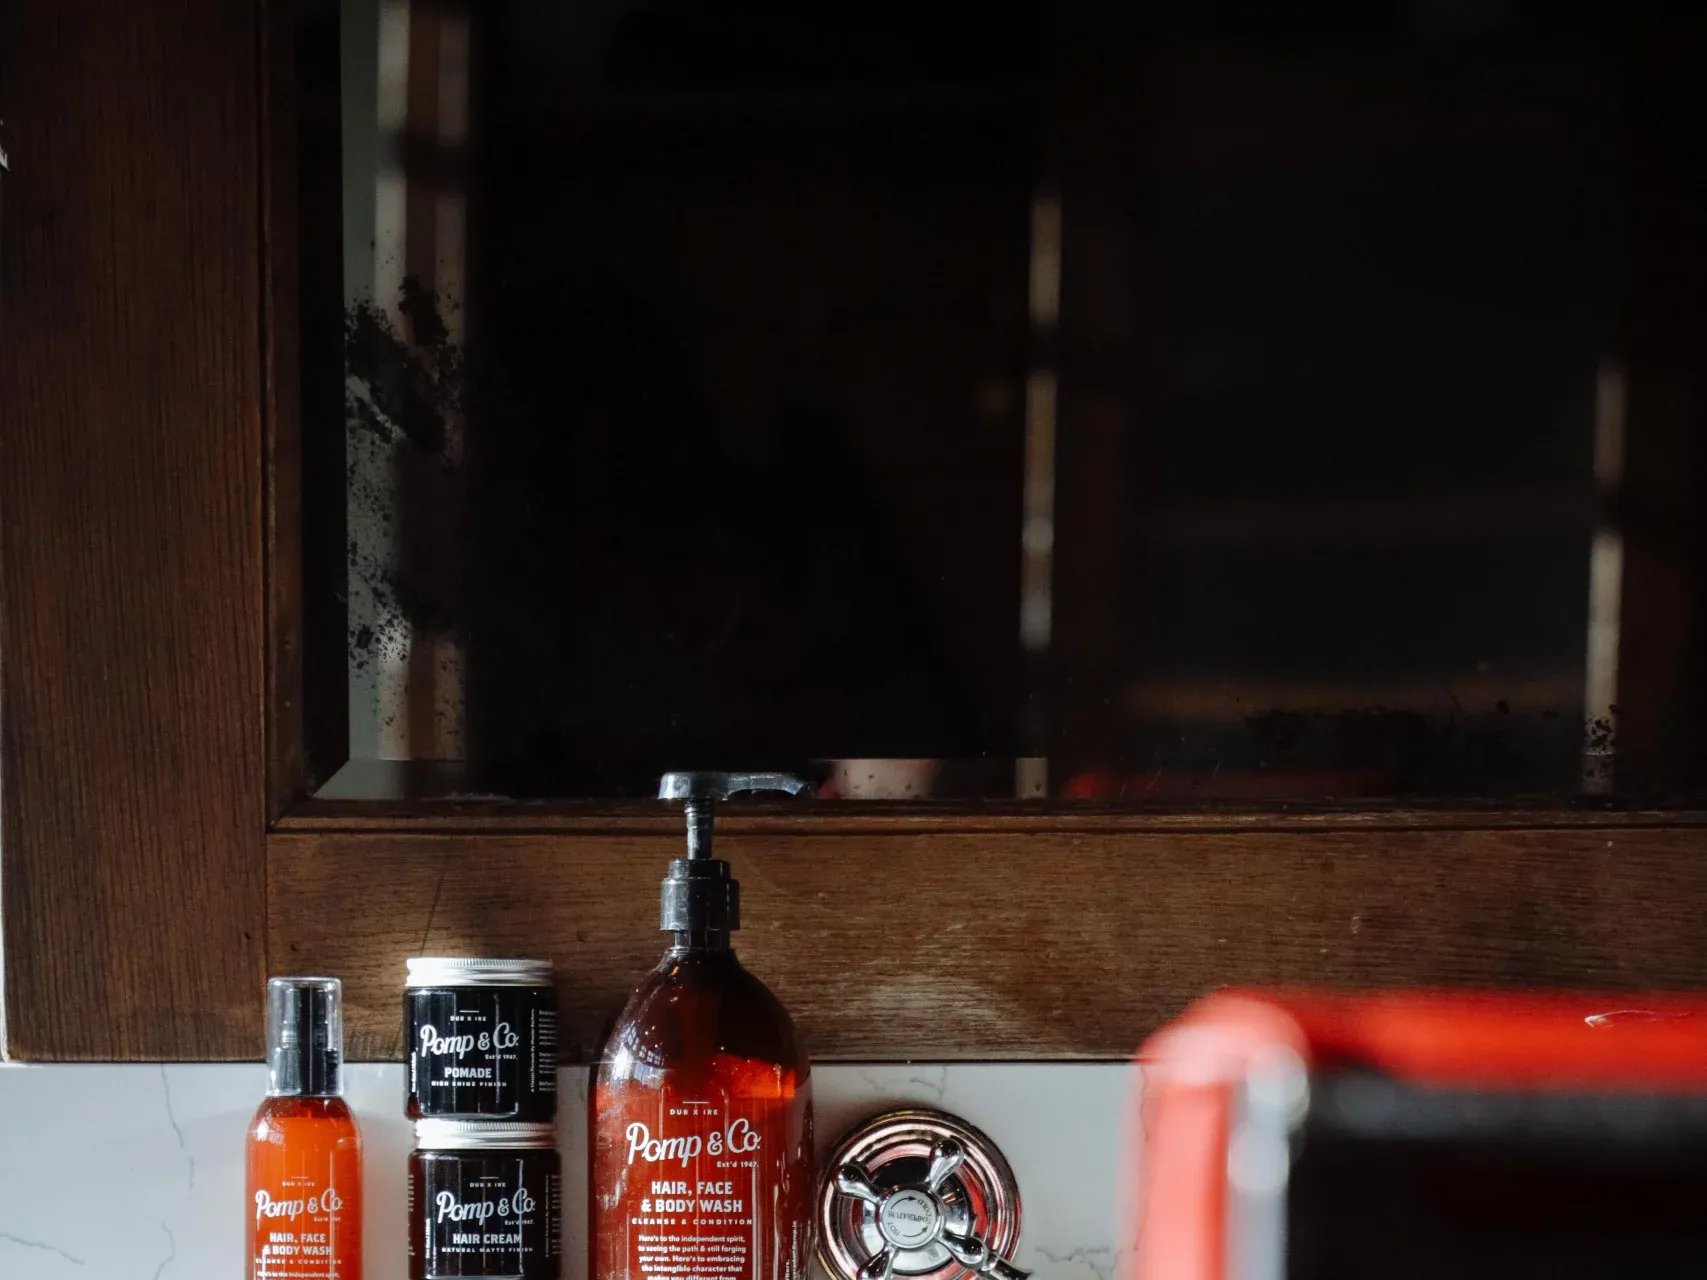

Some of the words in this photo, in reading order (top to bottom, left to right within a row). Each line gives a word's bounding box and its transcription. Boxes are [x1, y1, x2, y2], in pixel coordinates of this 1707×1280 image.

[420, 1024, 474, 1059] Pomp
[477, 1032, 490, 1050] &
[444, 1067, 492, 1078] POMADE
[625, 1122, 702, 1168] Pomp
[707, 1131, 722, 1156] &
[651, 1181, 693, 1196] HAIR,
[697, 1181, 733, 1195] FACE
[255, 1189, 304, 1222] Pomp
[307, 1197, 319, 1214] &
[436, 1190, 494, 1226] Pomp
[497, 1198, 509, 1217] &
[641, 1199, 652, 1213] &
[655, 1199, 695, 1213] BODY
[700, 1199, 742, 1213] WASH
[917, 1198, 932, 1217] COLD
[887, 1222, 901, 1237] HOT
[269, 1232, 298, 1243] HAIR,
[301, 1232, 326, 1243] FACE
[453, 1233, 480, 1244] HAIR
[483, 1233, 522, 1244] CREAM
[639, 1235, 660, 1243] Here's
[661, 1235, 667, 1243] to
[669, 1235, 680, 1243] the
[681, 1235, 725, 1243] independent
[272, 1245, 300, 1255] BODY
[302, 1245, 332, 1255] WASH
[638, 1245, 644, 1254] to
[646, 1245, 668, 1254] seeing
[669, 1245, 681, 1254] the
[682, 1245, 699, 1254] path
[700, 1245, 705, 1254] &
[708, 1245, 720, 1254] still
[721, 1245, 746, 1254] forging
[639, 1255, 654, 1264] your
[655, 1255, 671, 1264] own.
[673, 1255, 696, 1264] Here's
[697, 1255, 705, 1264] to
[707, 1255, 745, 1264] embracing
[642, 1265, 653, 1273] the
[654, 1265, 690, 1273] intangible
[692, 1265, 726, 1273] character
[728, 1265, 742, 1273] that
